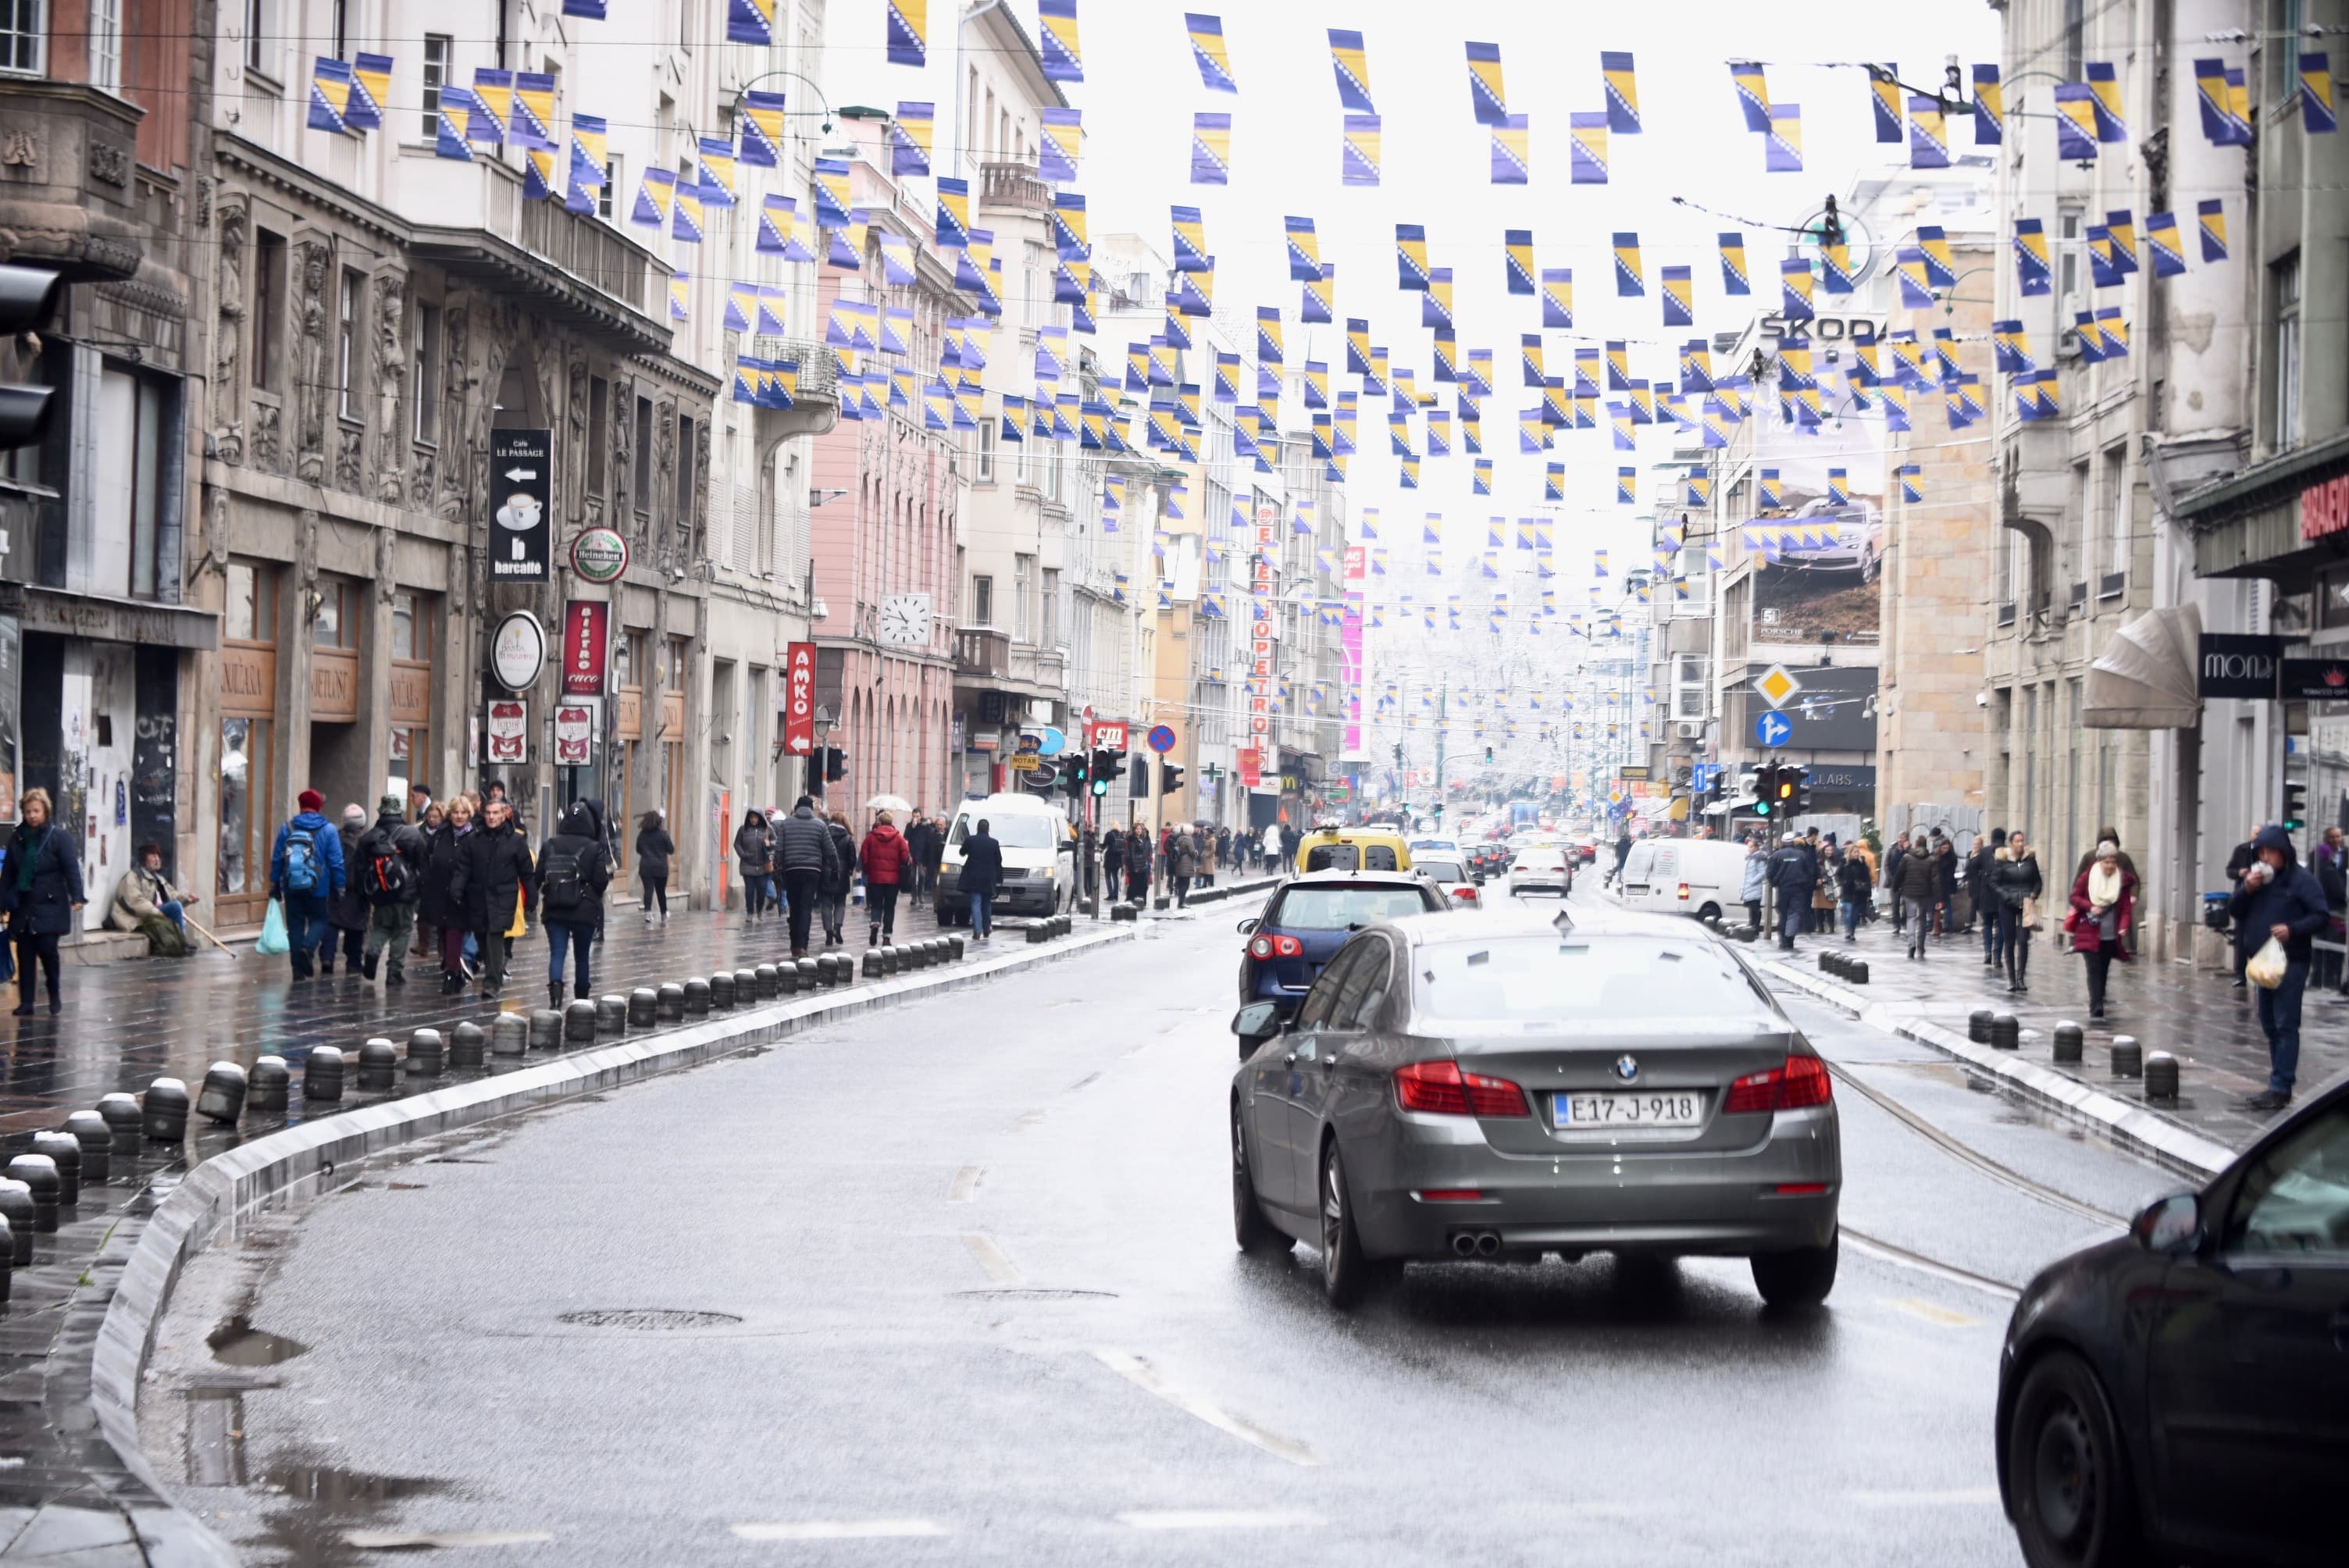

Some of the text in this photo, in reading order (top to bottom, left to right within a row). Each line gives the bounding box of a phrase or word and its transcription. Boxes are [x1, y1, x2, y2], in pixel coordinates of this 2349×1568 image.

[497, 448, 544, 458] LE PASSAGE
[579, 549, 619, 561] Heineken
[579, 606, 592, 670] BISTRO
[793, 650, 810, 715] AMKO
[1572, 1096, 1693, 1122] E17-J-918
